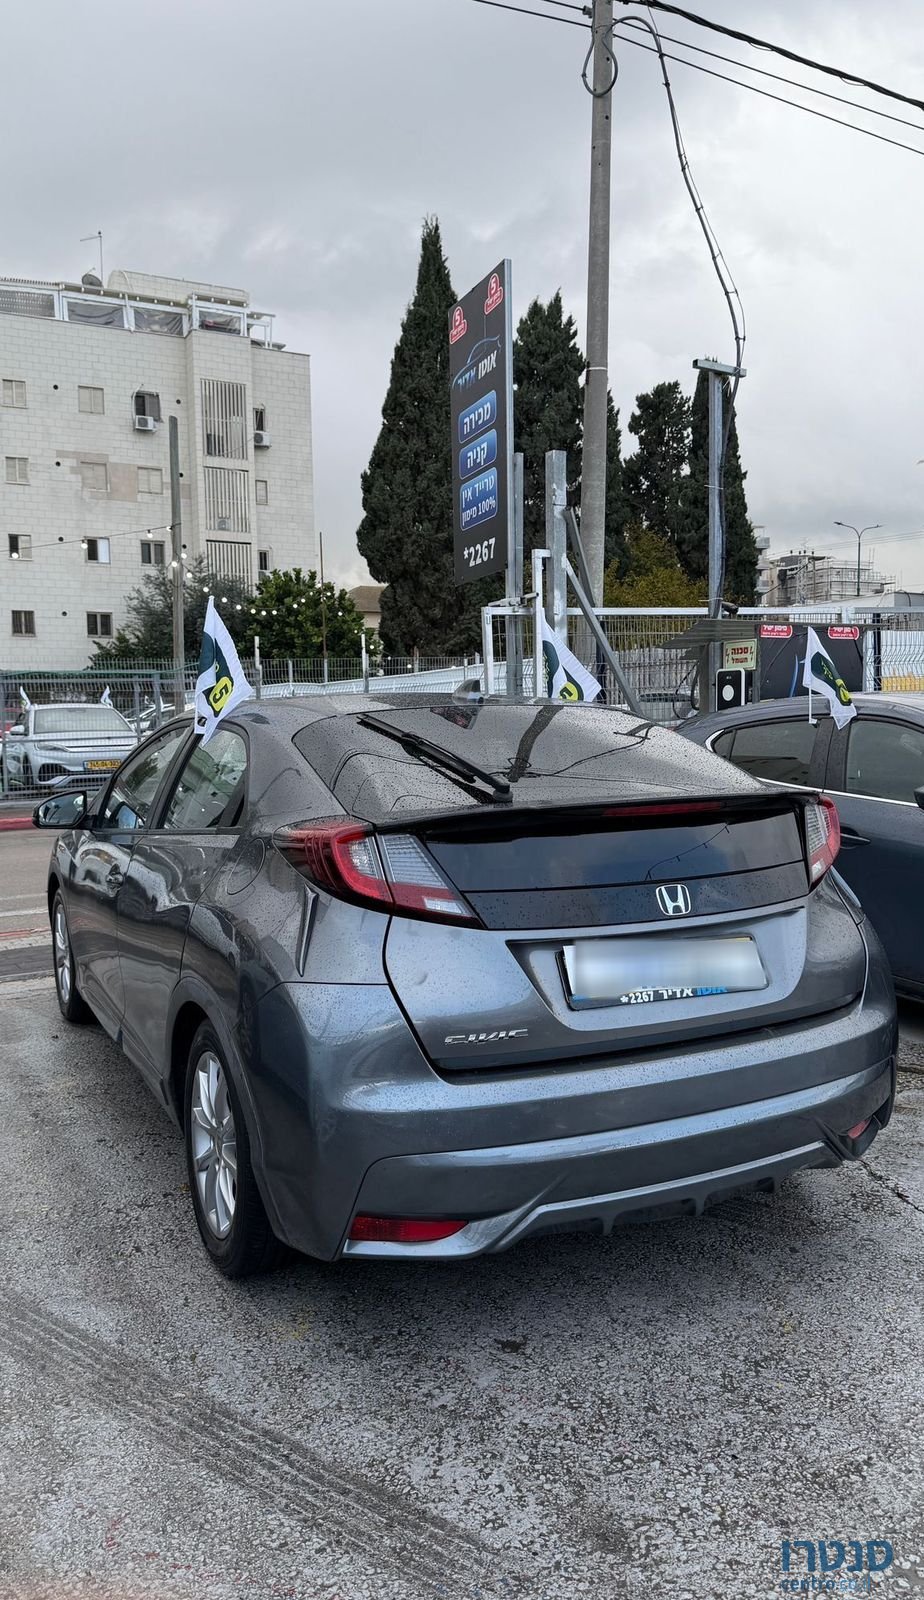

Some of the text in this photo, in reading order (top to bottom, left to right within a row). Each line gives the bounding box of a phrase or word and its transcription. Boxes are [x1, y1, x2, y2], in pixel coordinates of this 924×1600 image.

[478, 350, 497, 380] אוטו
[463, 402, 491, 435] מכירה
[467, 441, 488, 469] קניה
[462, 475, 495, 509] טרייד אין
[462, 495, 496, 526] 100% מימון
[731, 646, 749, 655] סכנה
[212, 683, 230, 704] 5
[659, 988, 693, 1000] אדיר
[444, 1029, 529, 1045] CIVIC
